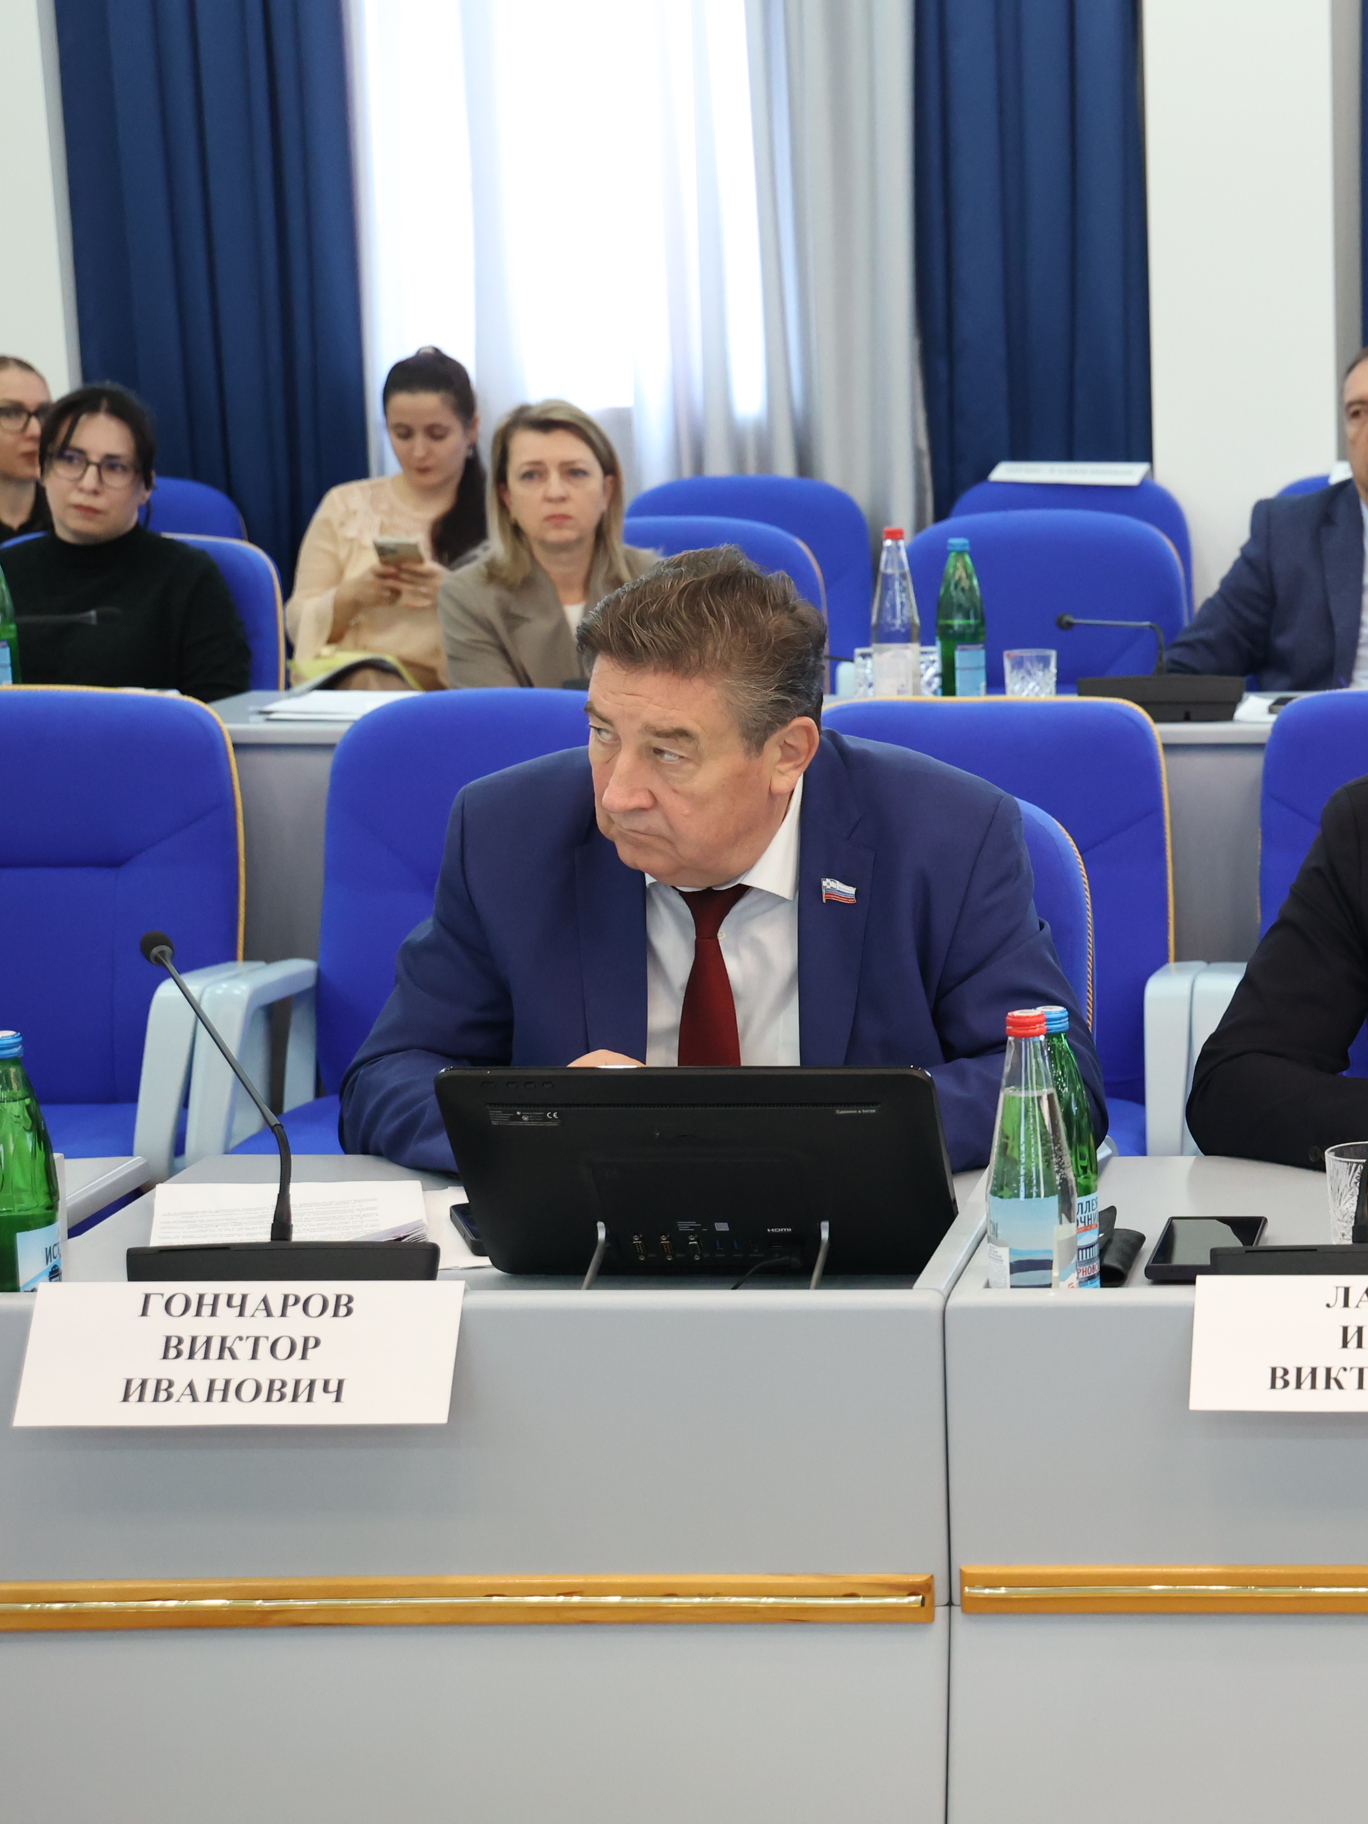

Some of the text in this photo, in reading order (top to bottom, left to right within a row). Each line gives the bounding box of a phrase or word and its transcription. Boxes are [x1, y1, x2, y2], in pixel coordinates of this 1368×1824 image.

[45, 1242, 61, 1266] ИС
[138, 1292, 355, 1319] ГОНЧАРОВ
[160, 1335, 322, 1361] ВИКТОР
[119, 1378, 347, 1403] ИВАНОВИЧ
